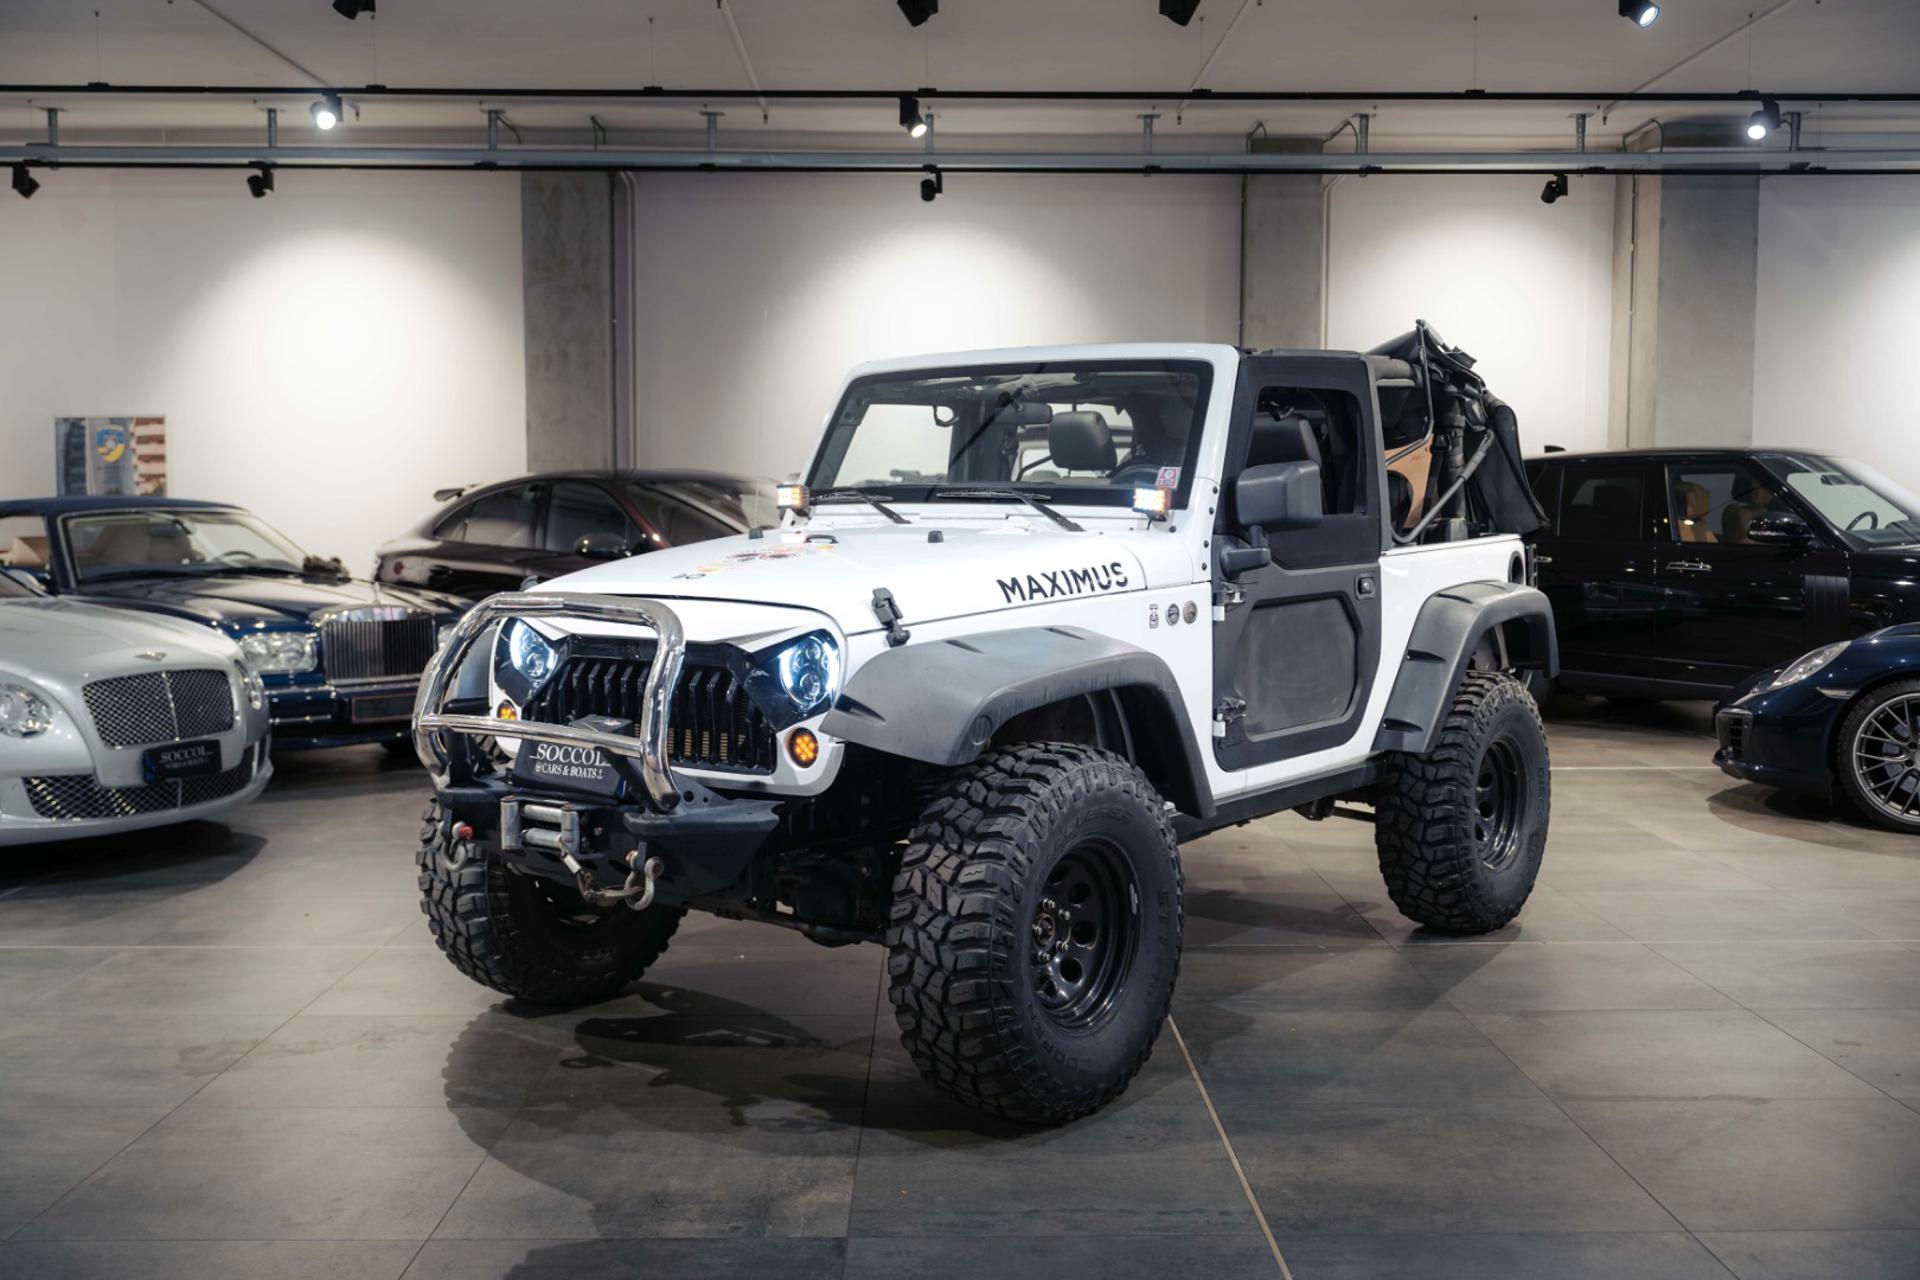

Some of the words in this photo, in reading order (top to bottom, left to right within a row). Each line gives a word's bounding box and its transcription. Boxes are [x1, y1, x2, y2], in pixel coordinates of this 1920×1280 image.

[997, 562, 1128, 603] MAXIMUS
[533, 743, 611, 767] SOCCOL
[541, 762, 561, 775] CARS
[562, 765, 570, 776] &
[570, 767, 597, 779] BOATS
